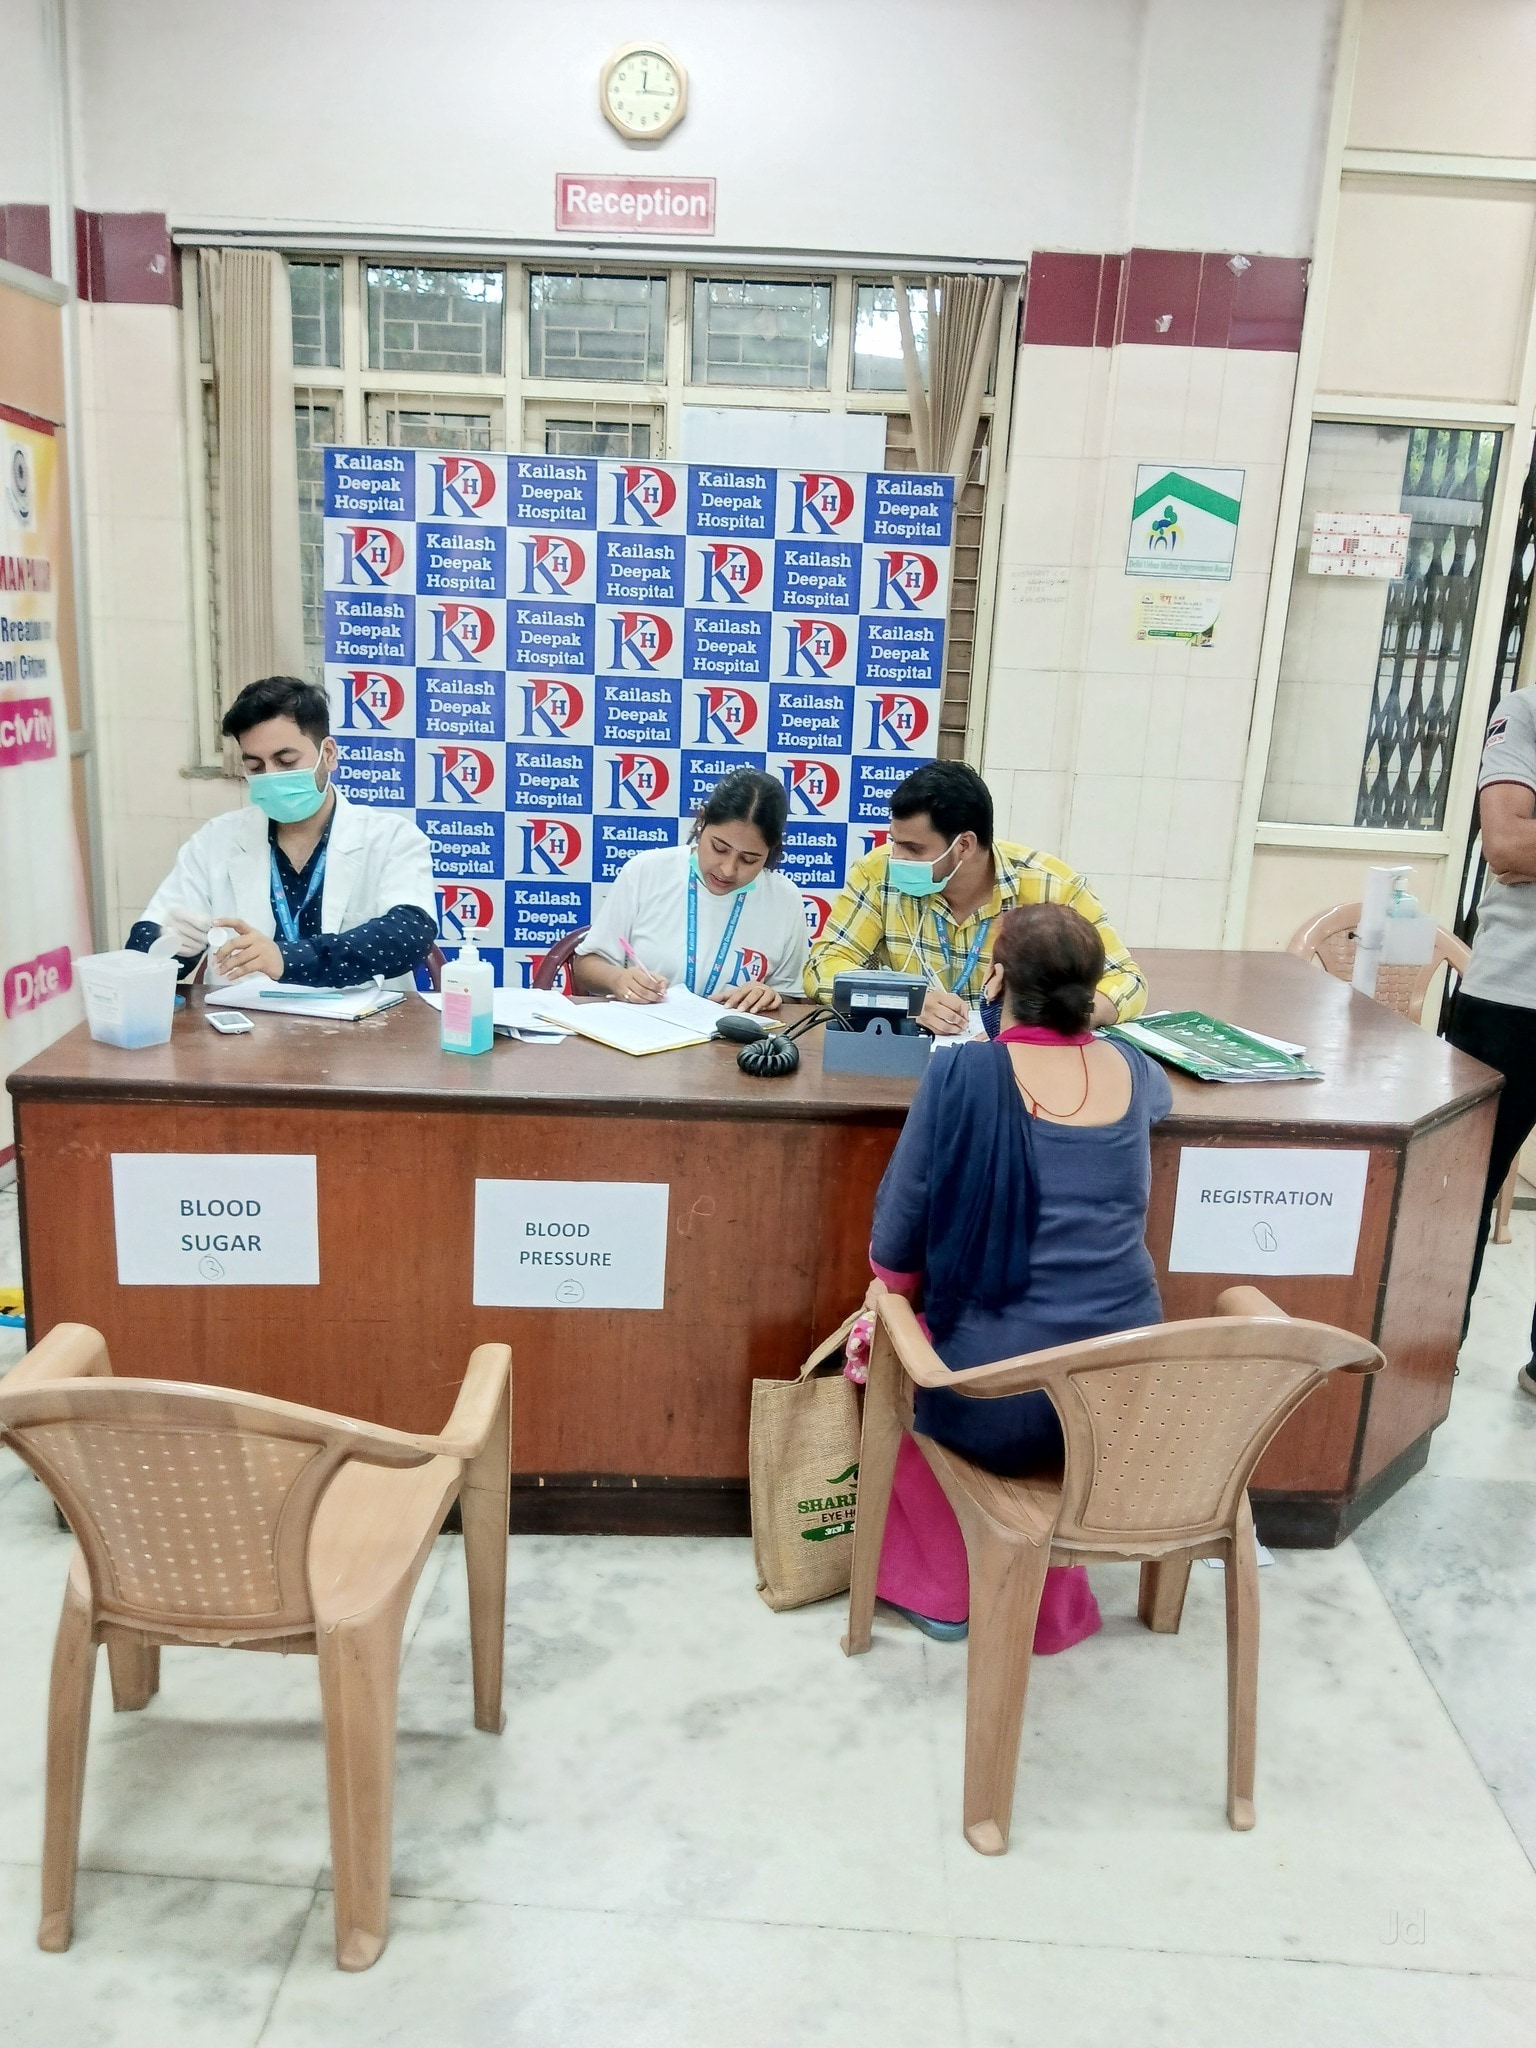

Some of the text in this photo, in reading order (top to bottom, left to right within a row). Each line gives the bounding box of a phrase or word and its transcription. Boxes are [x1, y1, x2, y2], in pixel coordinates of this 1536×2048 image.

[567, 185, 706, 222] Reception
[335, 454, 404, 471] Kailash
[518, 463, 587, 480] Kailash
[339, 476, 401, 493] Deepak
[699, 472, 766, 489] Kailash
[876, 480, 943, 496] Kailash
[522, 485, 583, 502] Deepak
[335, 495, 404, 513] Hospital
[702, 493, 761, 511] Deepak
[879, 501, 938, 518] Deepak
[518, 504, 586, 522] Hospital
[698, 513, 764, 530] Hospital
[875, 521, 940, 538] Hospital
[427, 534, 496, 551] Kailash
[607, 543, 675, 559] Kailash
[785, 551, 851, 567] Kailash
[431, 555, 491, 572] Deepak
[611, 564, 670, 581] Deepak
[788, 572, 846, 589] Deepak
[427, 574, 495, 592] Hospital
[607, 583, 673, 600] Hospital
[783, 591, 849, 608] Hospital
[335, 601, 405, 618] Kailash
[517, 610, 585, 626] Kailash
[694, 618, 761, 634] Kailash
[339, 622, 401, 639] Deepak
[869, 626, 934, 641] Kailash
[521, 631, 581, 648] Deepak
[698, 639, 756, 655] Deepak
[336, 641, 404, 658] Hospital
[871, 646, 929, 662] Deepak
[517, 650, 584, 667] Hospital
[693, 658, 759, 674] Hospital
[867, 665, 931, 681] Hospital
[427, 679, 495, 695] Kailash
[605, 687, 671, 702] Kailash
[430, 699, 491, 716] Deepak
[779, 694, 844, 709] Kailash
[608, 707, 667, 724] Deepak
[782, 714, 839, 730] Deepak
[427, 718, 494, 735] Hospital
[605, 726, 670, 742] Hospital
[778, 733, 842, 749] Hospital
[337, 746, 405, 762] Kailash
[516, 753, 583, 769] Kailash
[340, 766, 401, 783] Deepak
[520, 773, 579, 789] Deepak
[516, 792, 582, 808] Hospital
[427, 821, 494, 836] Kailash
[603, 827, 668, 841] Kailash
[431, 841, 491, 857] Deepak
[515, 891, 580, 905] Kailash
[519, 910, 577, 926] Deepak
[1201, 1190, 1333, 1206] REGISTRATION
[181, 1200, 261, 1216] BLOOD
[526, 1223, 590, 1237] BLOOD
[182, 1235, 261, 1251] SUGAR
[520, 1251, 611, 1266] PRESSURE
[822, 1511, 842, 1522] EYE
